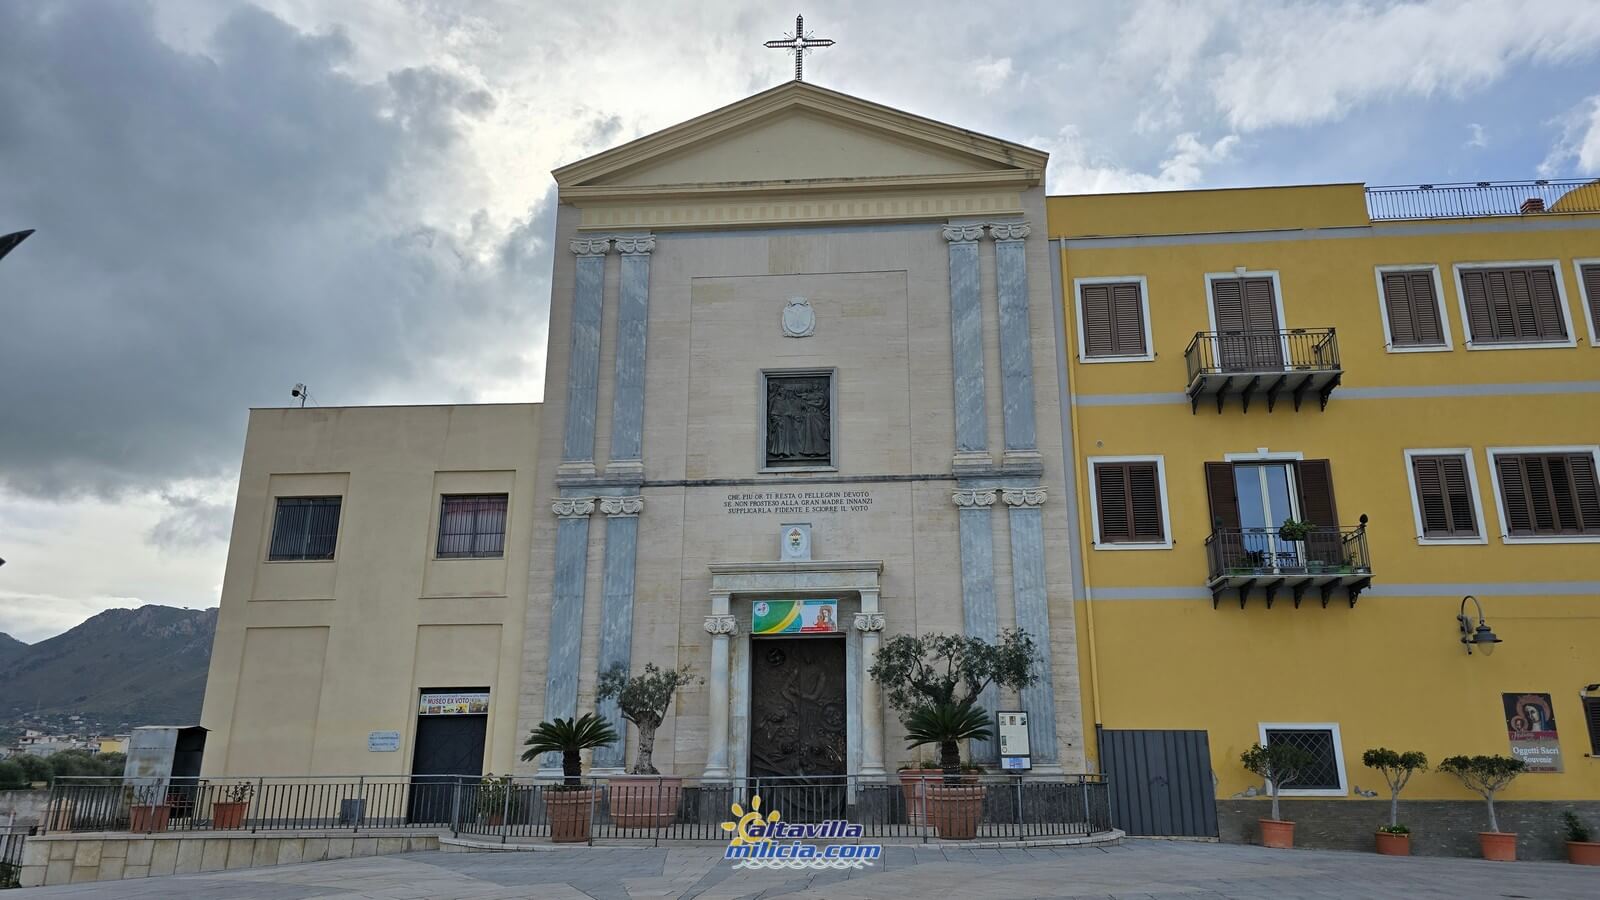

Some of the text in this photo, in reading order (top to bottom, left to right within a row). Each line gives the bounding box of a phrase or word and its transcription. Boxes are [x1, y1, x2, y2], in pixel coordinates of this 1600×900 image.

[850, 504, 869, 512] VOTO
[1512, 746, 1559, 756] Oggetti Sacri
